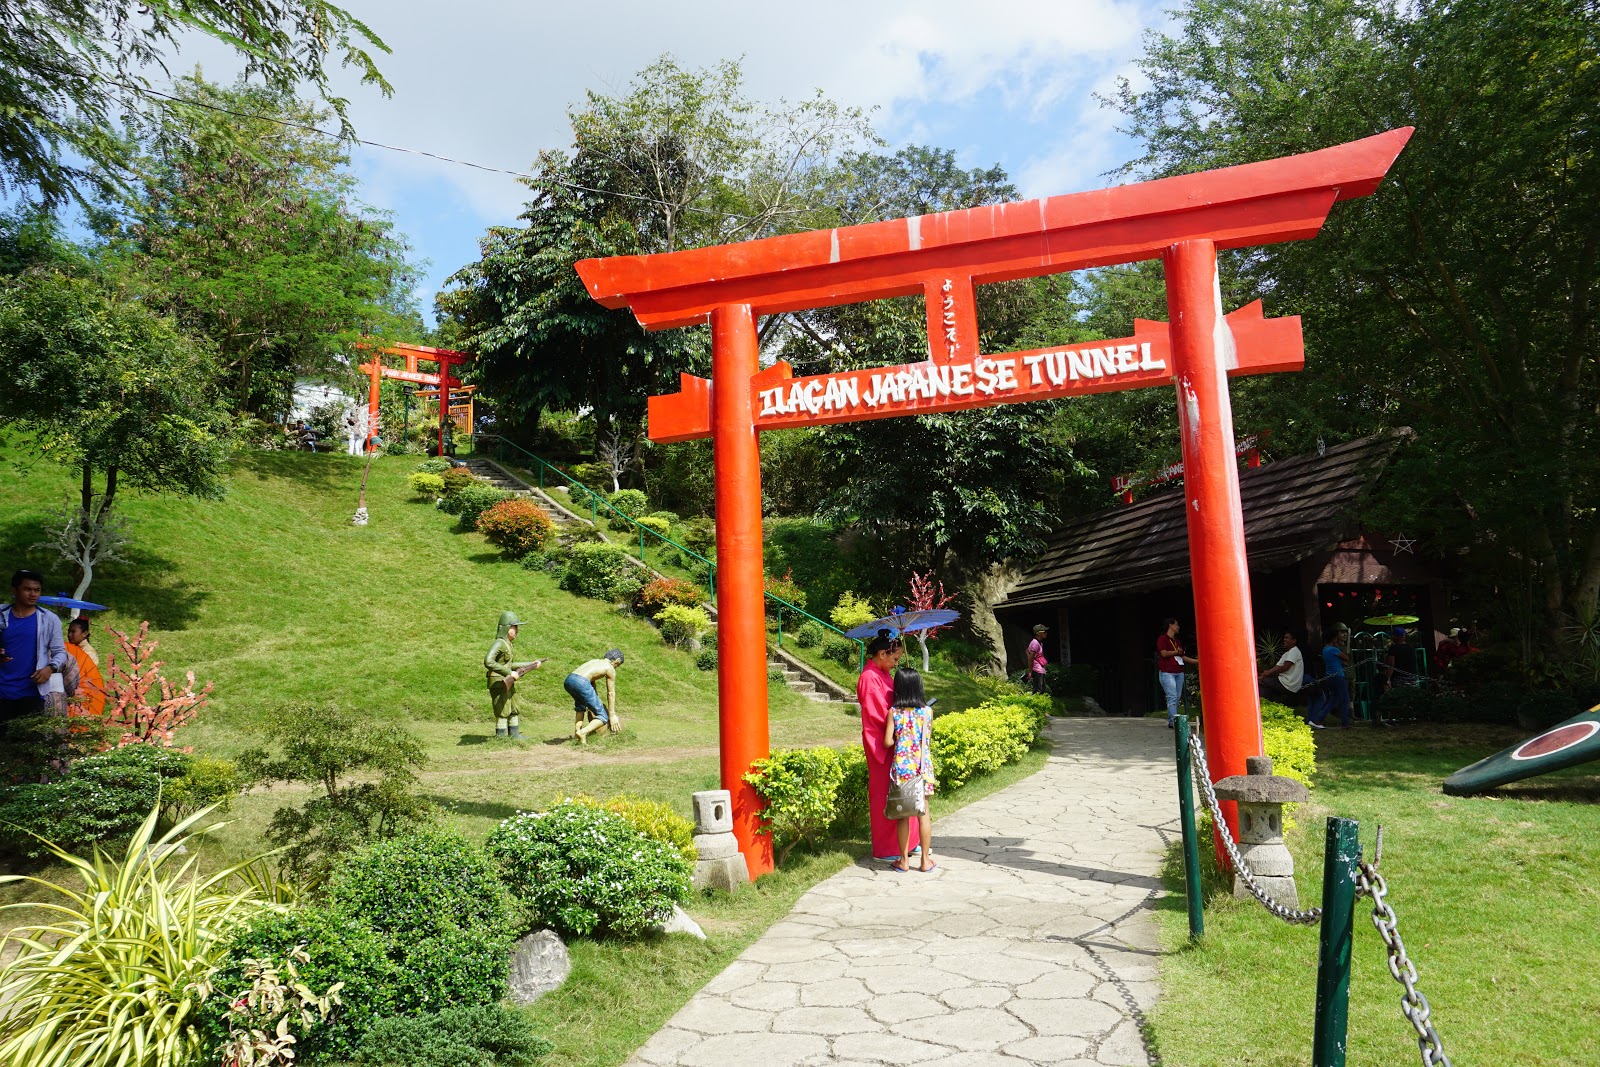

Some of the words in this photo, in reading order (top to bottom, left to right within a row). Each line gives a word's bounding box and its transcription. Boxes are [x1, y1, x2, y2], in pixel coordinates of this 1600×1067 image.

[759, 376, 860, 416] ILAGAN
[863, 358, 1018, 407] JAPANESE
[1023, 342, 1167, 386] TUNNEL
